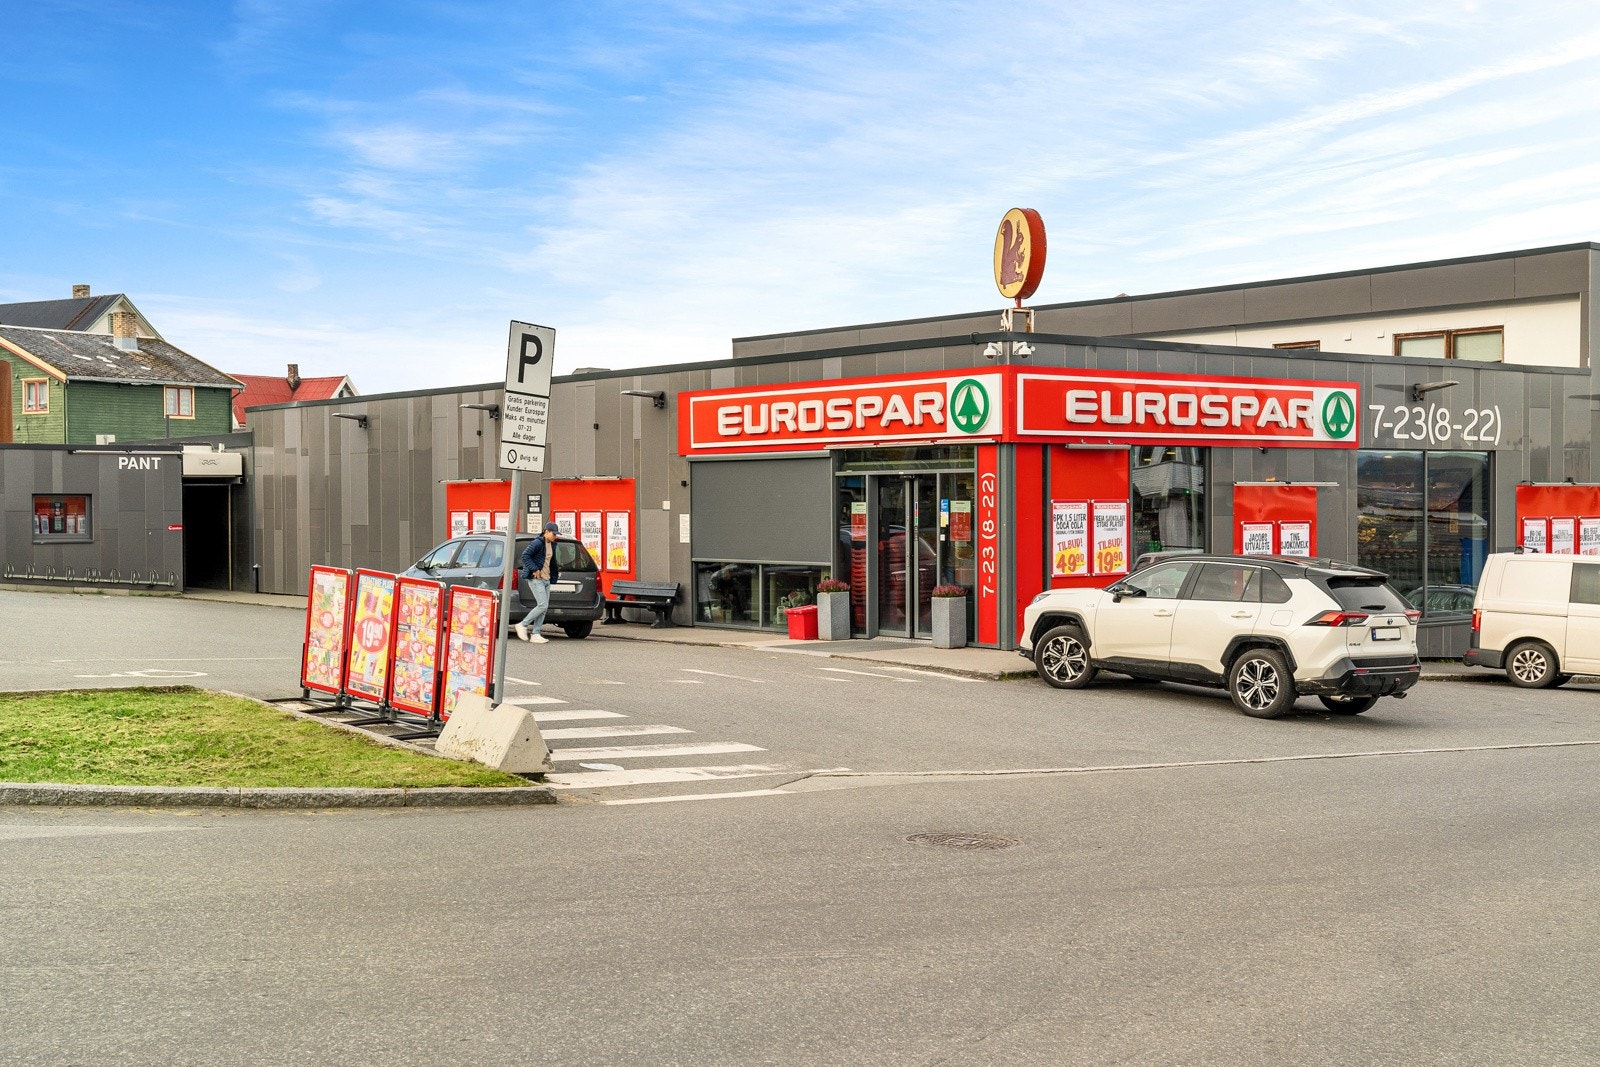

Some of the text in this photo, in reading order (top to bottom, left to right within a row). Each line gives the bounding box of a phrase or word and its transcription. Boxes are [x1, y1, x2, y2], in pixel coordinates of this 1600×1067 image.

[517, 332, 543, 384] P
[507, 395, 546, 408] Gratis parkering
[506, 404, 546, 416] Kunder Eurospar
[717, 390, 945, 436] EUROSPAR
[1065, 389, 1315, 429] EUROSPAR
[504, 413, 517, 421] Maks
[526, 416, 546, 424] minutter
[1368, 402, 1502, 446] 7-23(8-22)
[522, 433, 537, 442] dager
[118, 456, 162, 470] PANT
[1073, 514, 1086, 522] LITER
[1055, 521, 1084, 530] COCA COLA
[980, 472, 997, 598] 7-23 (8-22)
[1290, 532, 1300, 541] TINE
[1056, 537, 1083, 552] TILBUD!
[1097, 537, 1123, 551] TILBUD!
